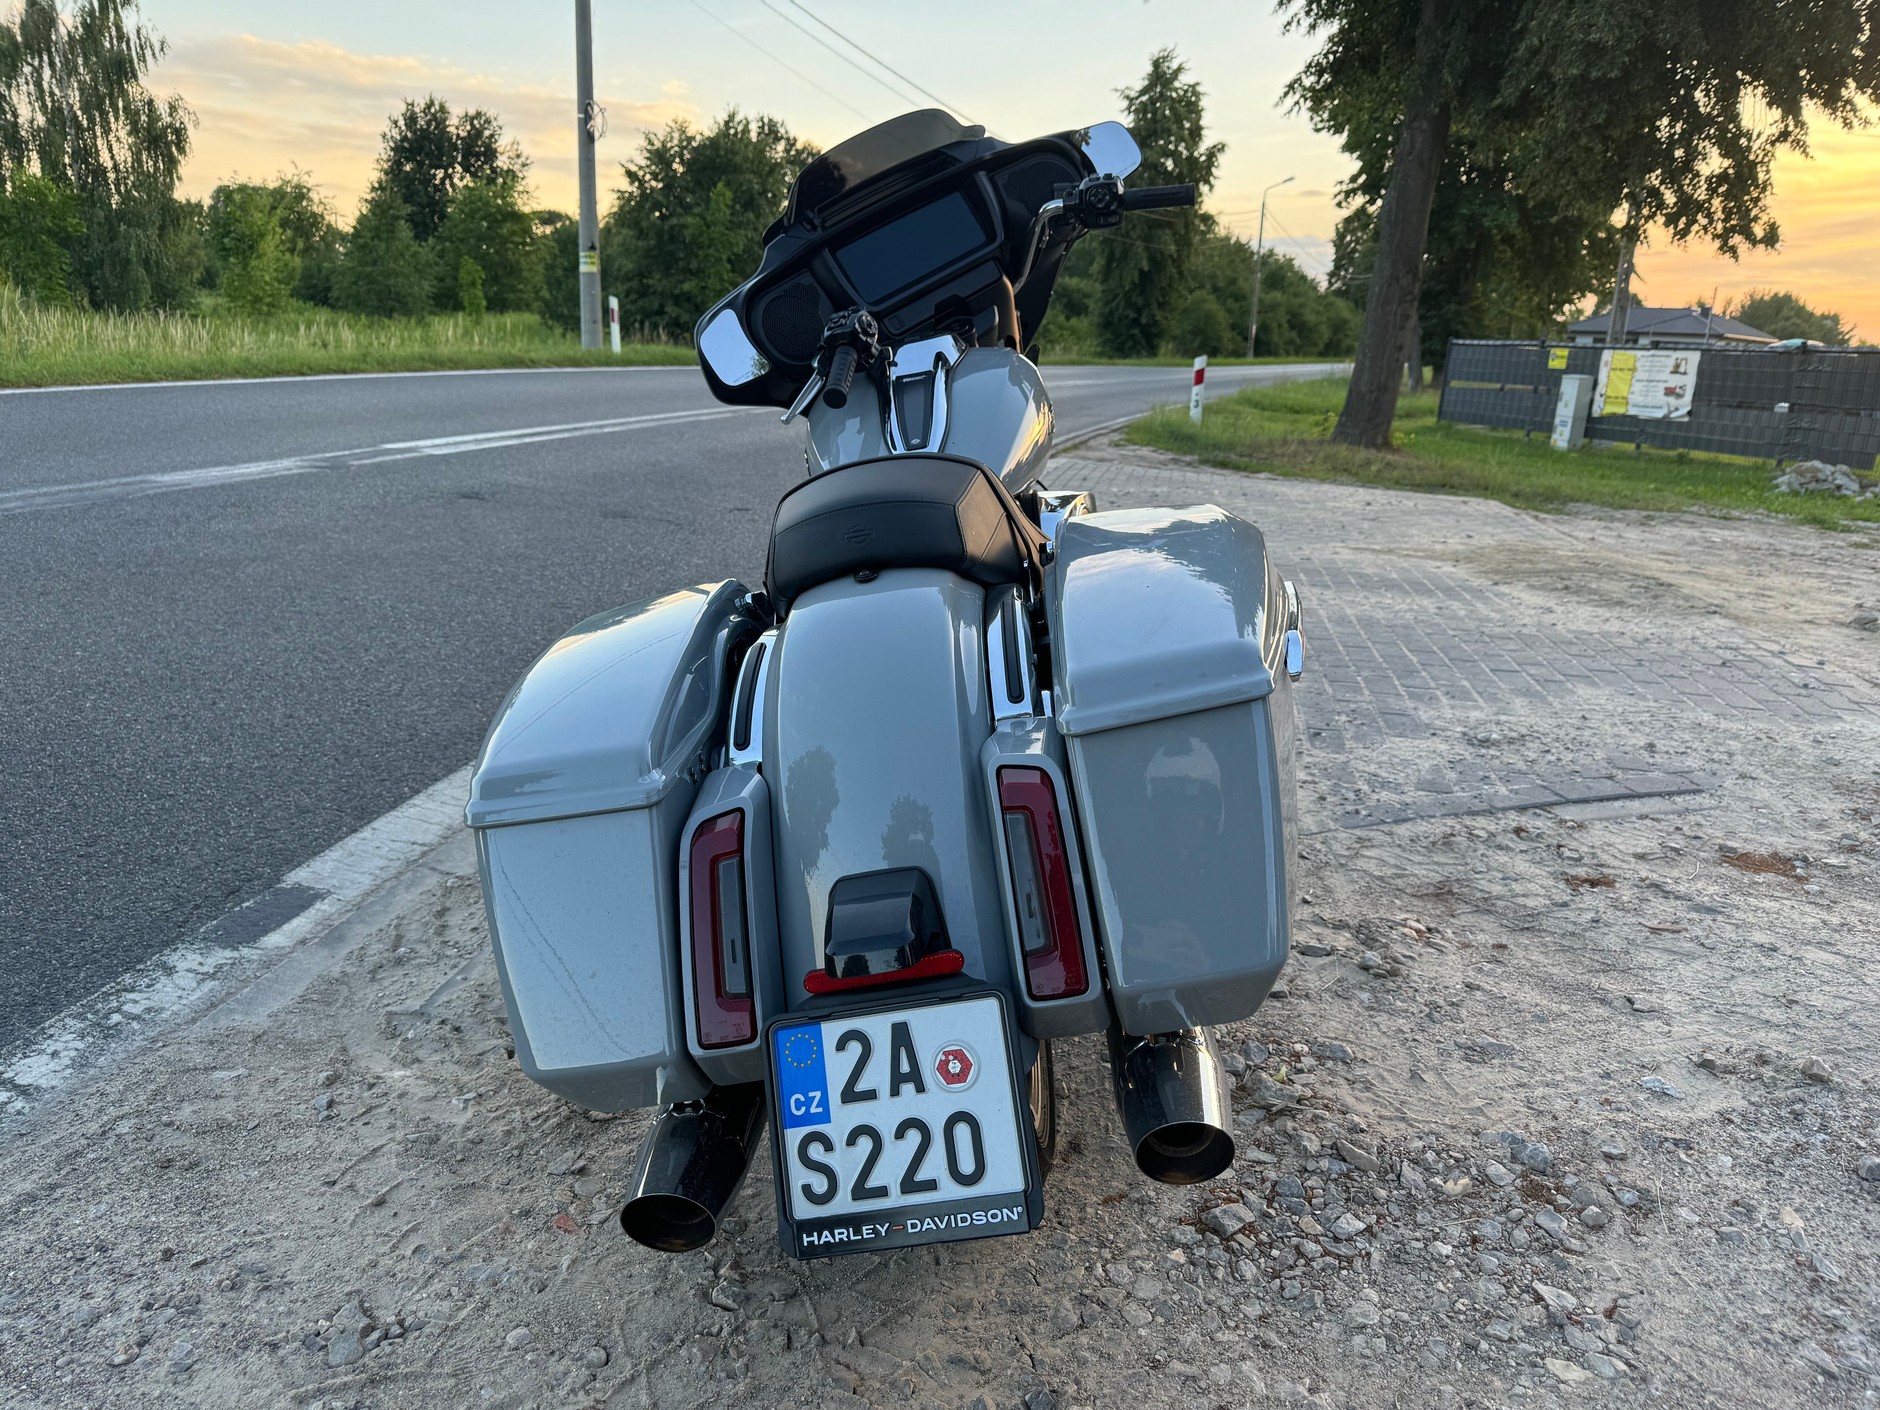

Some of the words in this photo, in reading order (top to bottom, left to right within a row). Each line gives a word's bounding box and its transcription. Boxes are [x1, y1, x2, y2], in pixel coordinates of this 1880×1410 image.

[790, 1091, 823, 1116] CZ
[835, 1021, 926, 1104] 2A
[797, 1110, 986, 1206] S220
